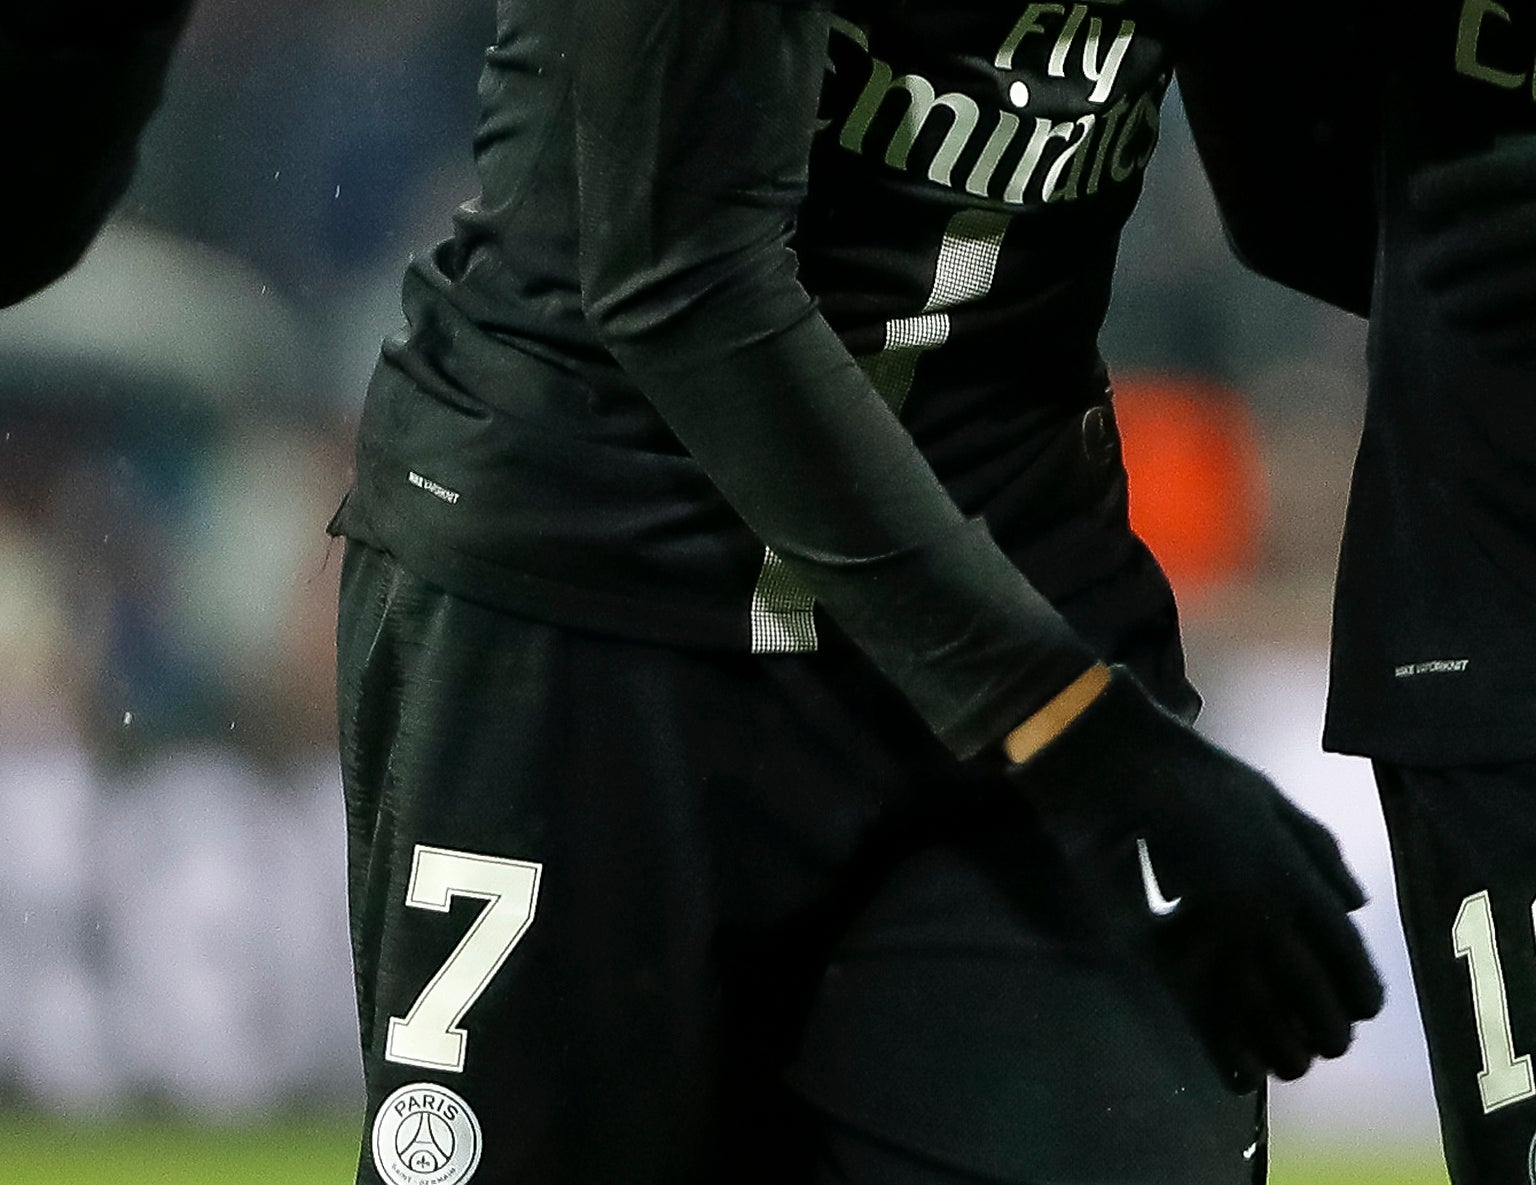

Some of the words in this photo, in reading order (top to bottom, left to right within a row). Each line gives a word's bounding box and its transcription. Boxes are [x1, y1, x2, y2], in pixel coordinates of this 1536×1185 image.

[994, 3, 1136, 103] Fly
[385, 844, 543, 1073] 7
[394, 1094, 460, 1122] PARIS
